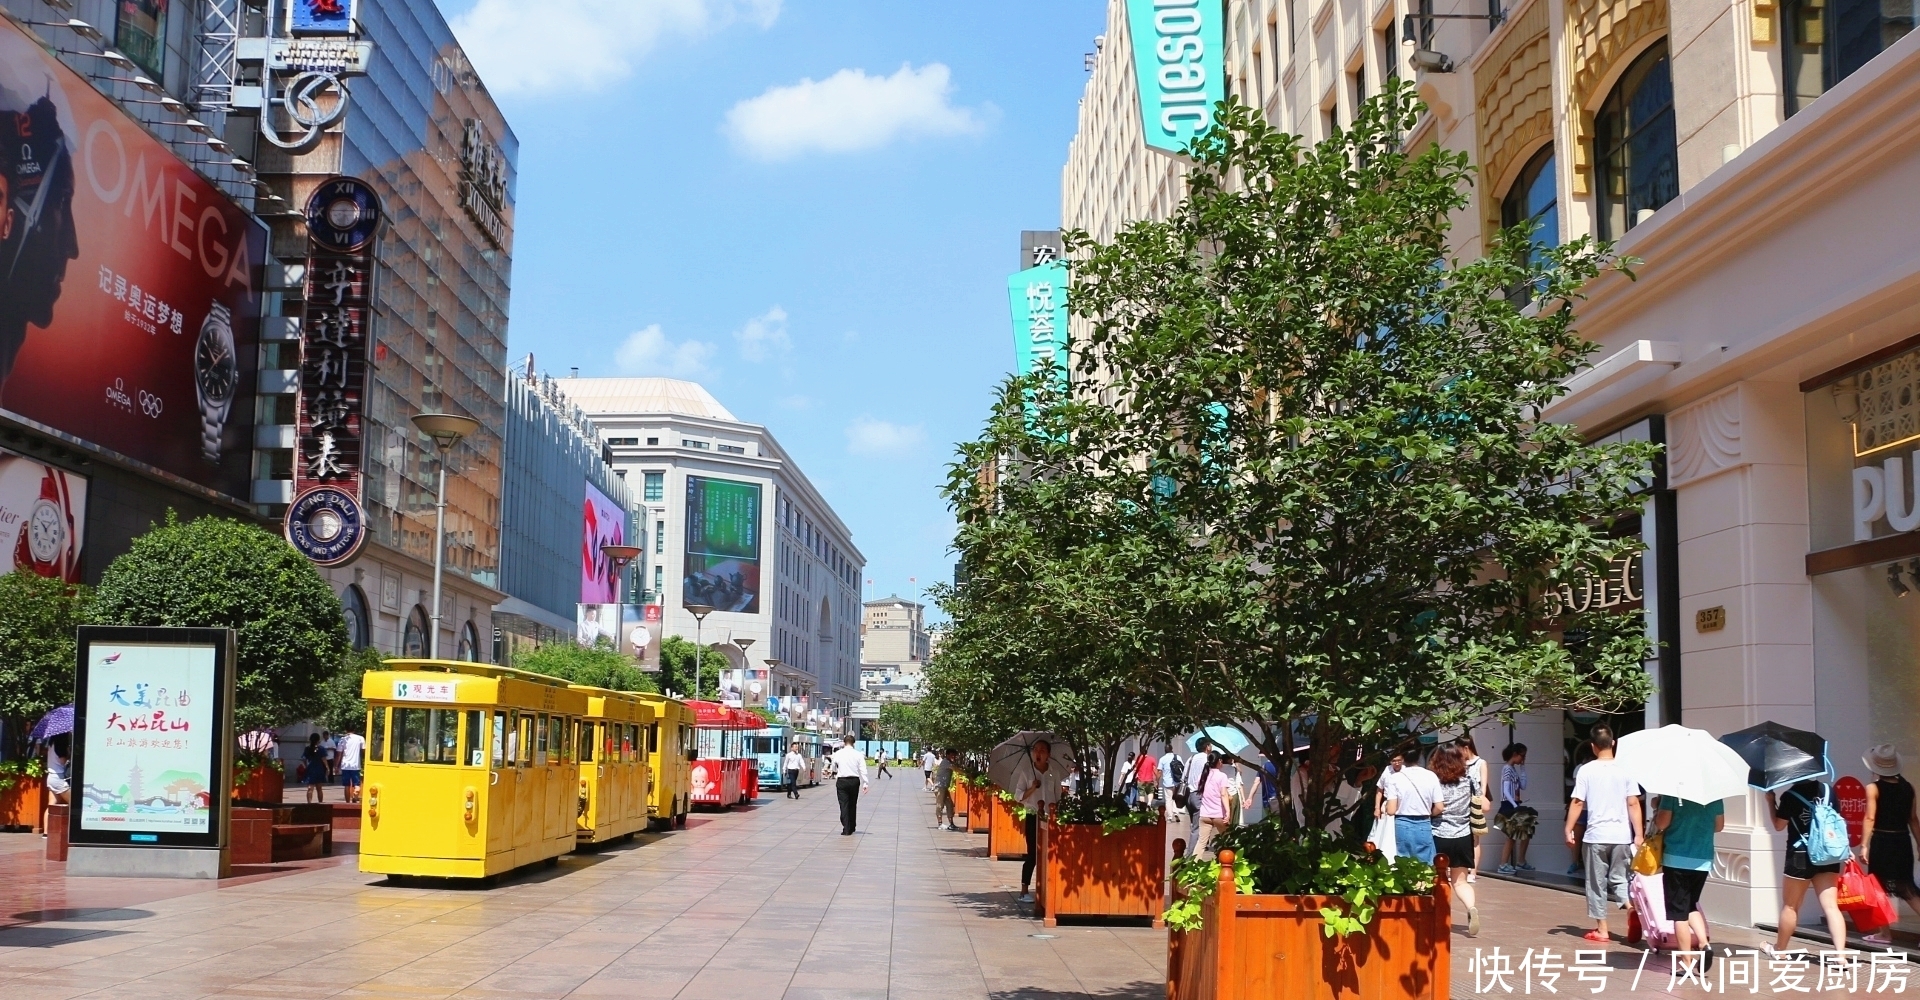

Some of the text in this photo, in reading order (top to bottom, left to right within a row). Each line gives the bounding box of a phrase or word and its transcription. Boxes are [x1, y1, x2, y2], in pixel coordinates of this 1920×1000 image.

[287, 41, 348, 51] HUALIAN
[275, 50, 359, 60] COMMERCIAL
[286, 59, 346, 68] BUILDING
[16, 161, 41, 175] OMEGA
[334, 183, 355, 194] XII
[84, 119, 254, 304] OMEGA
[467, 180, 506, 249] YOUNGOR
[334, 232, 349, 244] VI
[98, 264, 183, 335] 记录奥运梦想
[124, 309, 157, 336] 始于1932年
[105, 387, 132, 408] OMEGA
[1699, 608, 1720, 623] 357
[109, 683, 191, 709] 大美昆曲
[413, 684, 449, 694] 观光车
[106, 710, 190, 732] 大好昆山
[474, 752, 483, 765] 2
